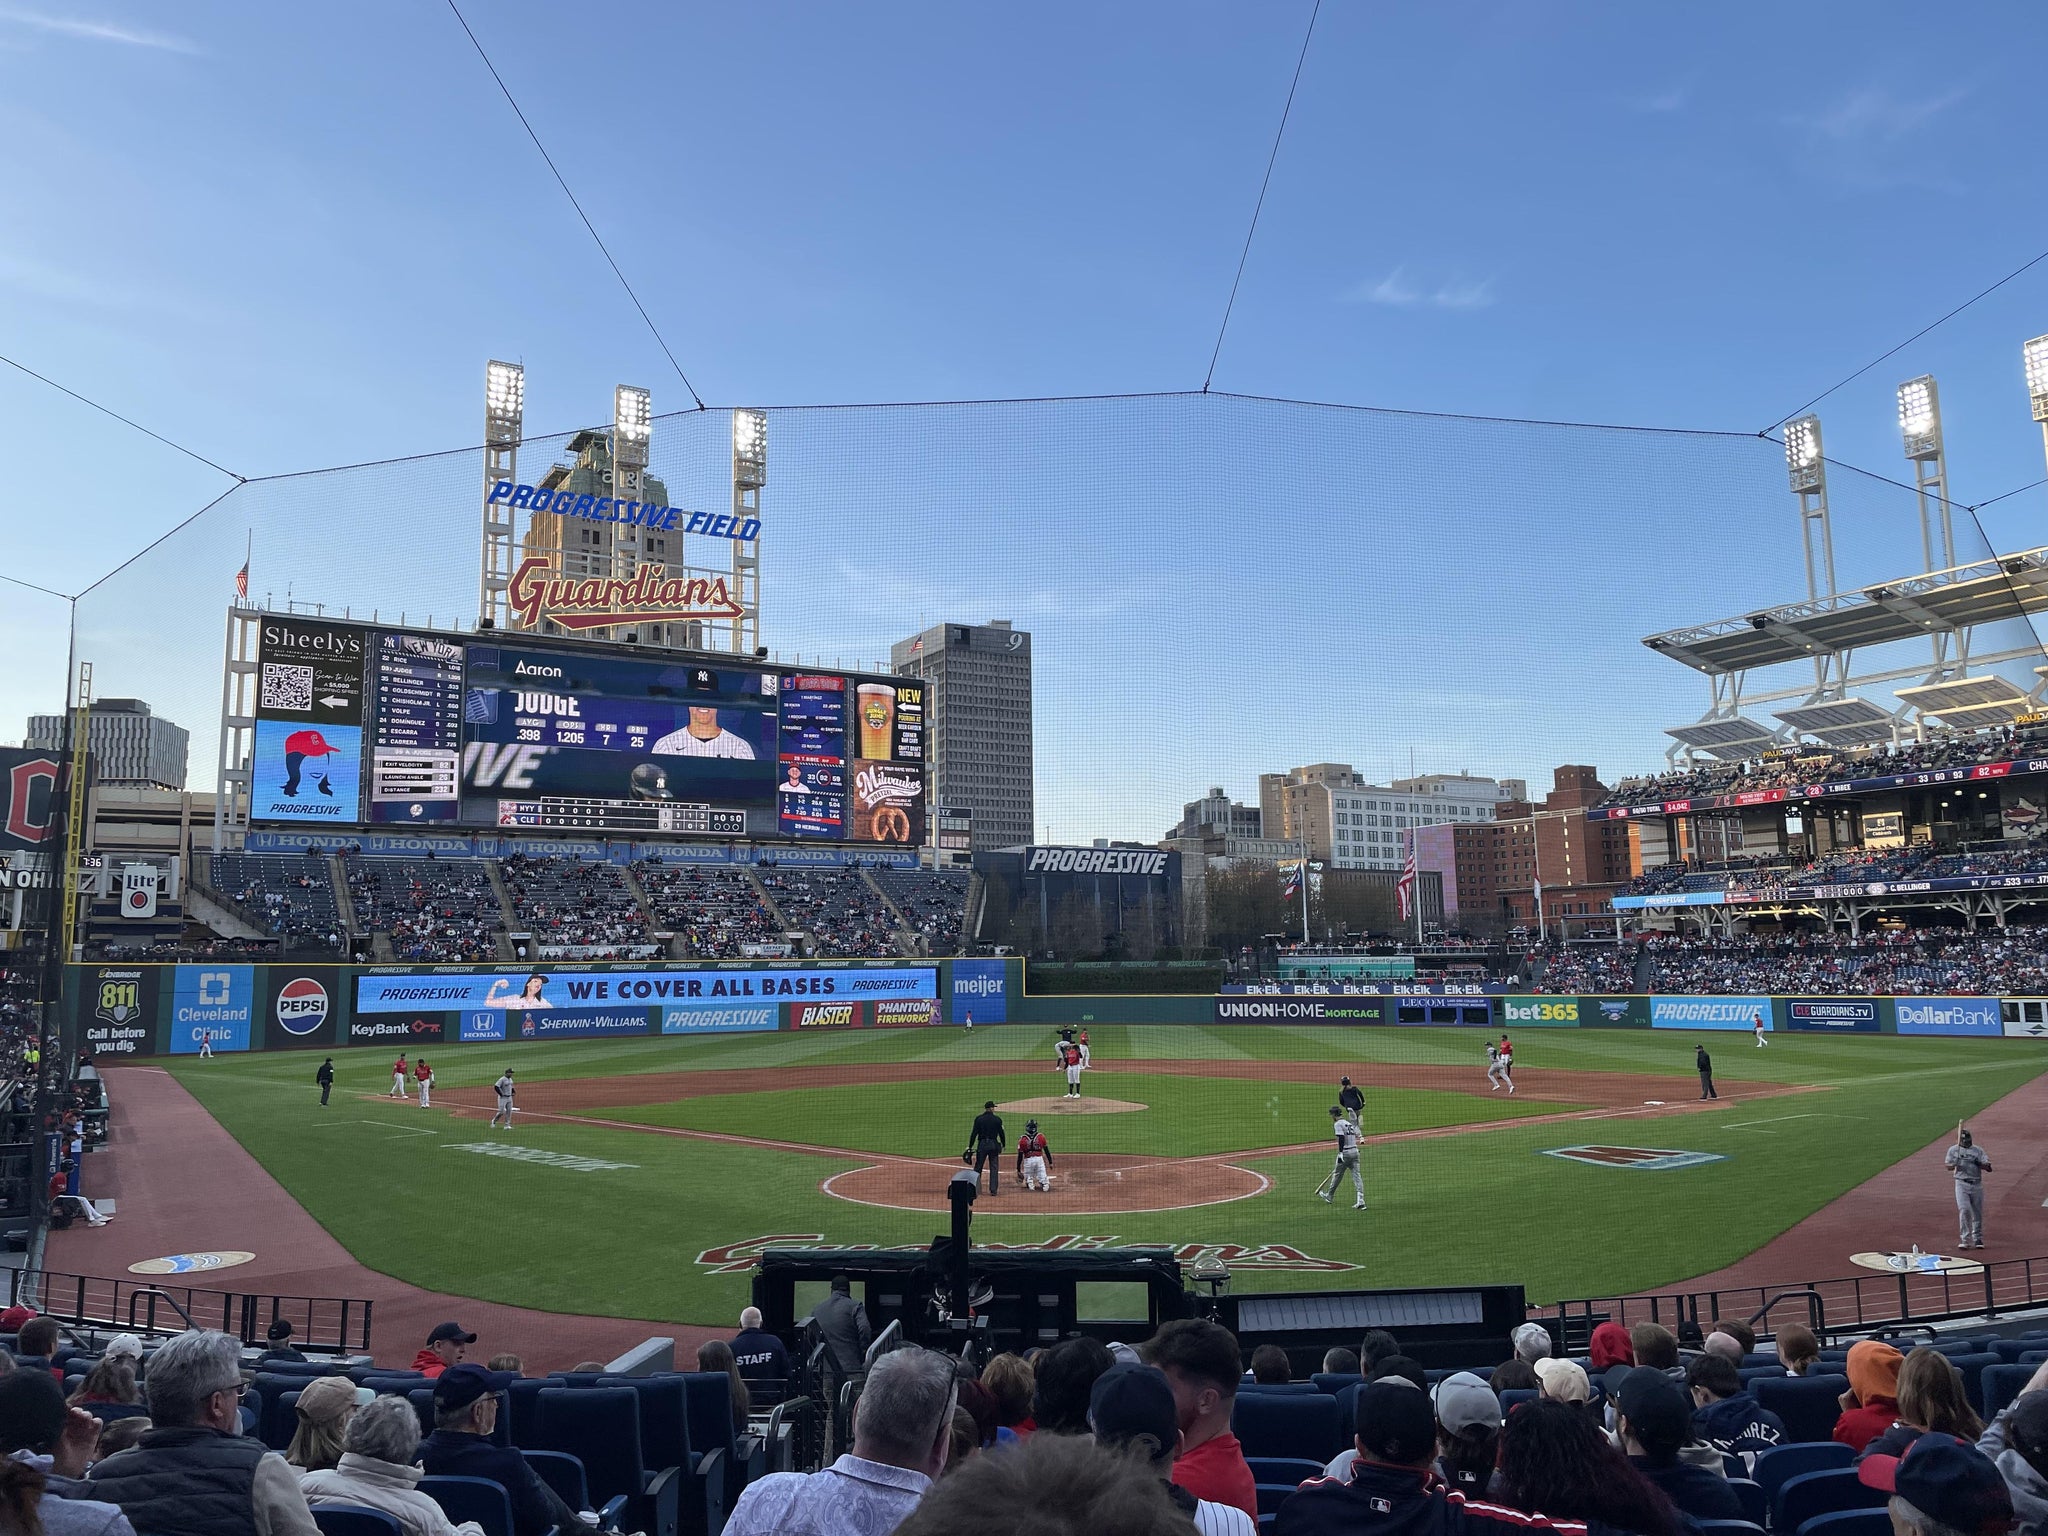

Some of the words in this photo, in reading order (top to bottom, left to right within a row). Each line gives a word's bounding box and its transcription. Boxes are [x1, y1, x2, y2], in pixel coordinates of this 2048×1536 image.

[487, 481, 683, 530] PROGRESSIVE
[686, 512, 761, 541] FIELD
[508, 556, 745, 629] Guardians
[265, 627, 360, 654] Sheely's
[1004, 633, 1023, 651] 9
[393, 656, 407, 664] RICE
[515, 659, 562, 678] Aaron
[393, 677, 424, 685] BELLINGER
[392, 687, 433, 696] GOLDSCHMIDT
[897, 688, 921, 703] NEW
[514, 691, 581, 717] JUDGE
[516, 729, 541, 741] .398
[556, 731, 585, 744] 1.205
[603, 734, 610, 745] 7
[630, 736, 644, 748] 25
[1780, 746, 1802, 755] DAVIS
[856, 765, 921, 799] Milwaukee
[1918, 774, 1928, 783] 33
[1953, 771, 1963, 780] 93
[1979, 767, 1990, 776] 82
[1809, 786, 1820, 795] 28
[269, 802, 343, 817] PROGRESSIVE
[520, 803, 535, 812] NYY
[1647, 805, 1661, 813] TOTAL
[520, 816, 535, 824] CLE
[277, 835, 363, 848] HONDA
[389, 839, 469, 851] HONDA
[527, 843, 600, 854] HONDA
[657, 846, 724, 858] HONDA
[774, 851, 836, 861] HONDA
[855, 853, 912, 863] HONDA
[83, 857, 102, 867] 7:36
[1028, 849, 1168, 875] PROGRESSIVE
[126, 874, 155, 890] Lite
[1871, 885, 1882, 894] 35
[1897, 882, 1931, 892] BELLINGER
[2003, 877, 2021, 887] .533
[368, 966, 413, 974] PROGRESSIVE
[664, 962, 702, 970] PROGRESSIVE
[379, 987, 472, 1000] PROGRESSIVE
[568, 981, 609, 1000] WE
[617, 979, 702, 999] COVER
[710, 978, 753, 996] ALL
[762, 977, 835, 995] BASES
[852, 979, 919, 991] PROGRESSIVE
[955, 975, 1003, 997] meijer
[102, 983, 135, 1009] 811
[280, 1000, 326, 1013] PEPSI
[878, 1002, 930, 1012] PHANTOM
[1325, 1009, 1380, 1018] MORTGAGE
[1504, 1002, 1579, 1021] bet365
[1654, 1003, 1765, 1022] PROGRESSIVE
[178, 1007, 247, 1022] Cleveland
[665, 1009, 772, 1027] PROGRESSIVE
[801, 1006, 853, 1026] BLASTER
[877, 1013, 930, 1024] FIREWORKS
[87, 1027, 108, 1040] Call
[111, 1027, 146, 1039] before
[191, 1026, 232, 1041] Clinic
[351, 1022, 410, 1037] KeyBank
[463, 1031, 502, 1039] HONDA
[95, 1042, 115, 1054] you
[116, 1040, 136, 1053] dig.
[735, 1352, 772, 1366] STAFF
